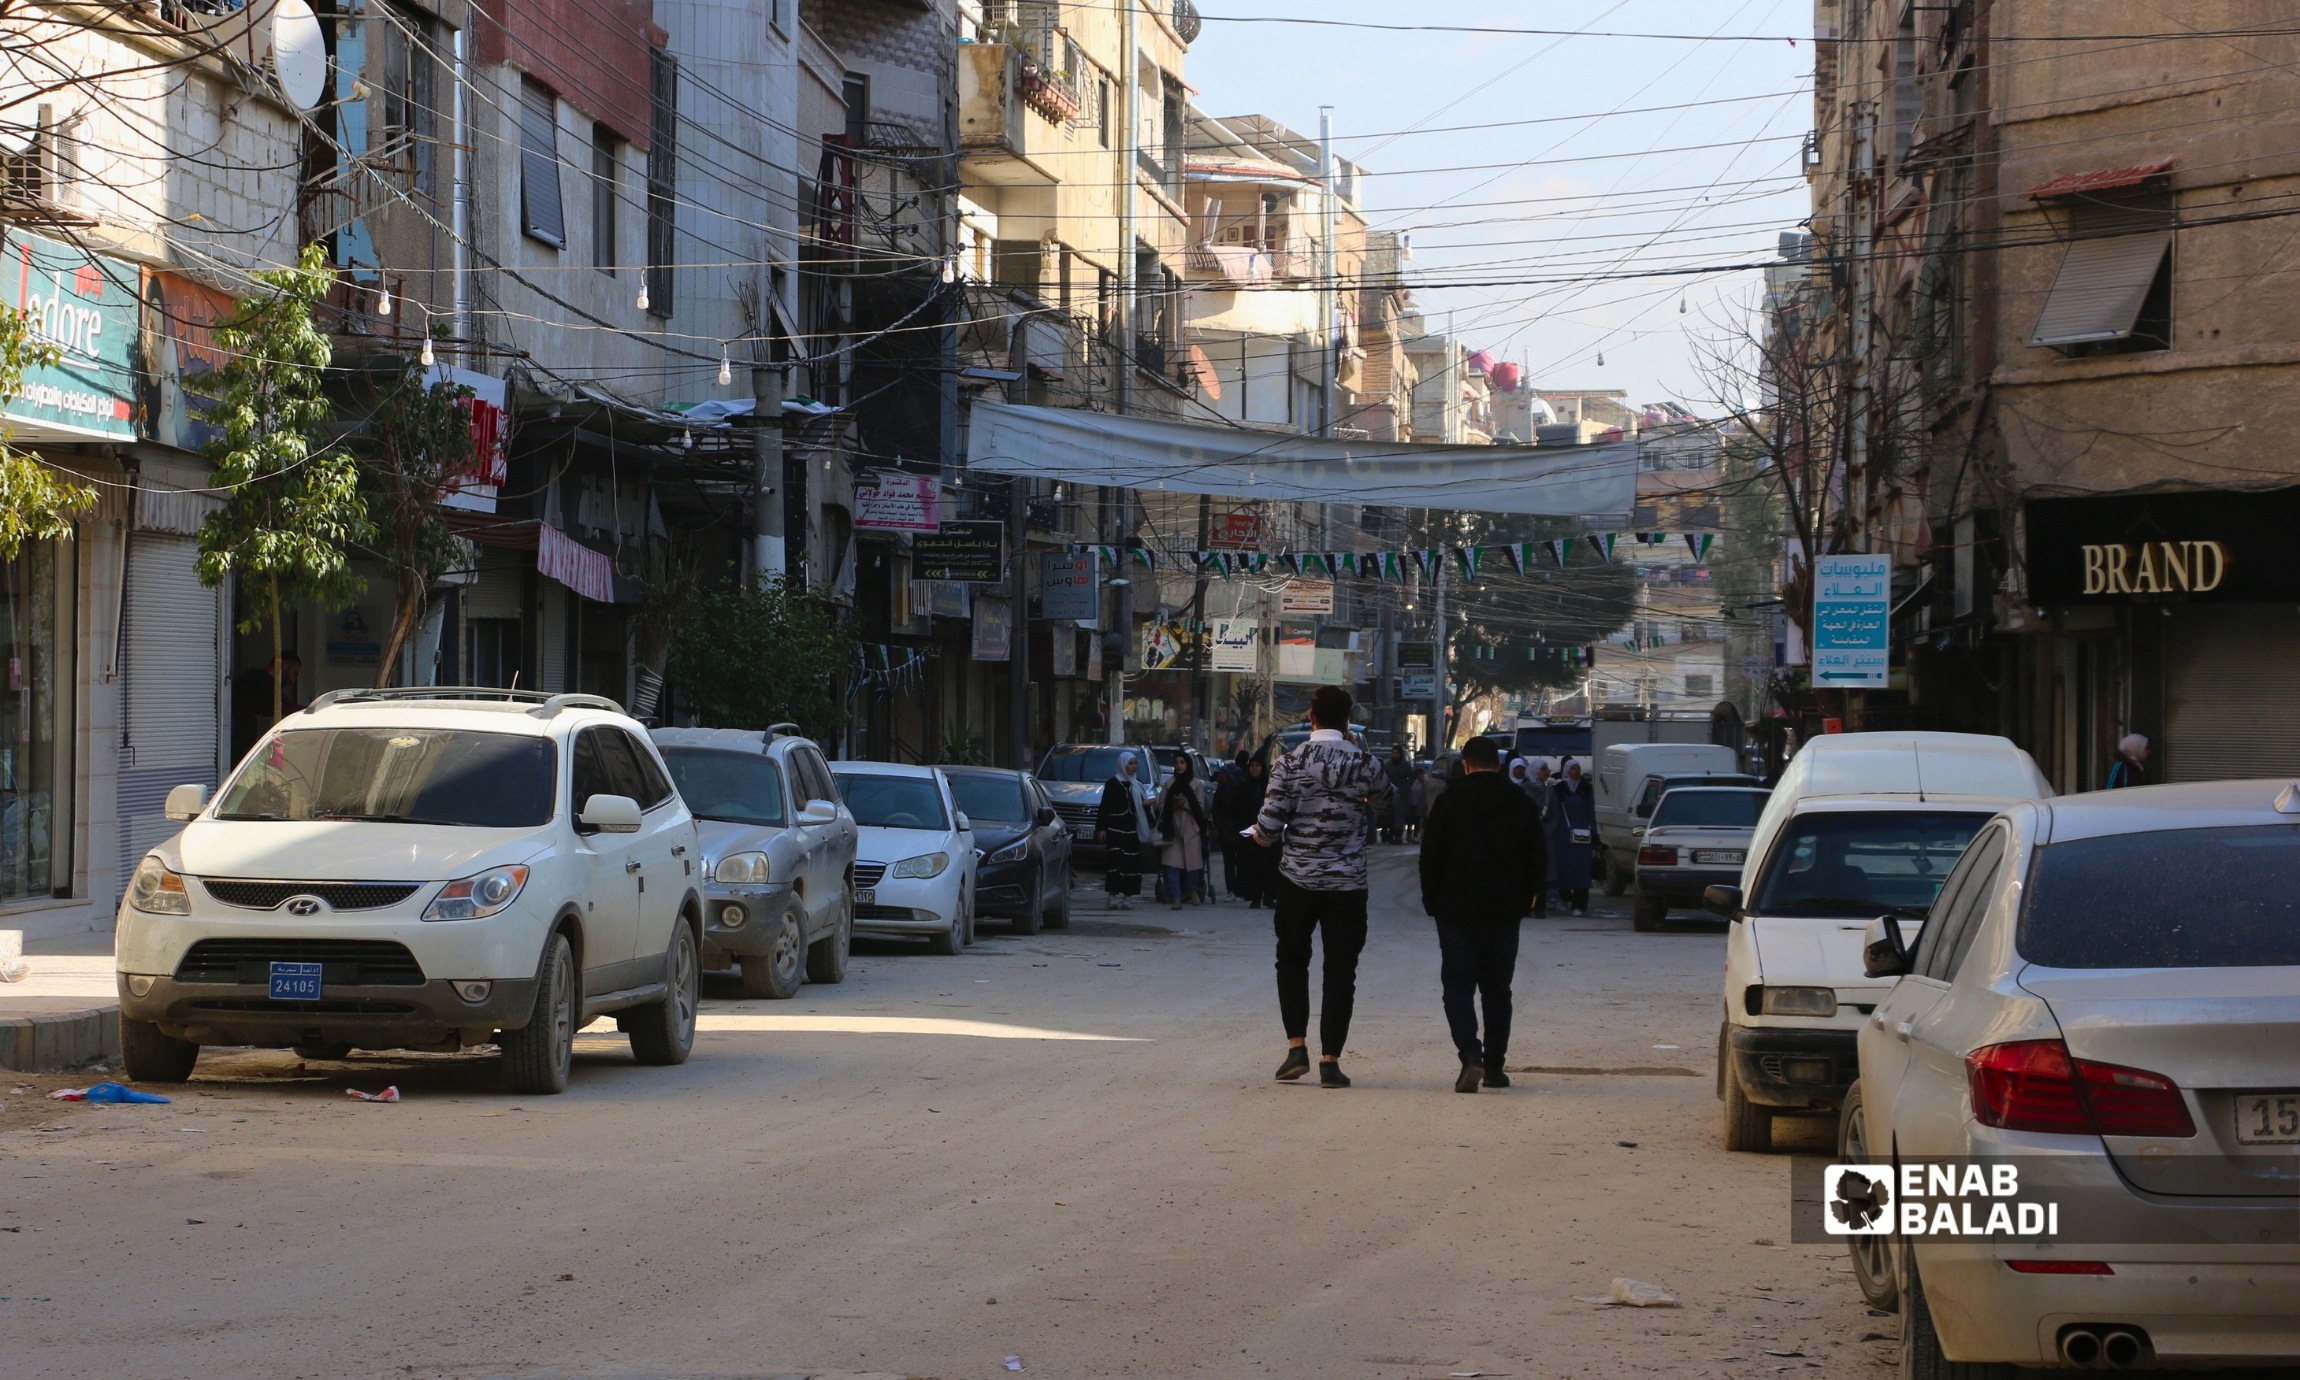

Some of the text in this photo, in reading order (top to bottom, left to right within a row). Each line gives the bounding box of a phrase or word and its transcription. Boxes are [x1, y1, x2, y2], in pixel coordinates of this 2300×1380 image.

[883, 488, 896, 499] فؤاد
[942, 527, 973, 535] الدكتورة
[1820, 560, 1886, 579] ملبوسات
[2082, 541, 2224, 594] BRAND
[1046, 575, 1090, 587] هاوس
[1823, 582, 1882, 597] العلاء
[1832, 605, 1859, 616] المحل
[1860, 604, 1885, 616] انتقل
[1822, 620, 1881, 632] الحارة في الجهة
[1831, 634, 1871, 646] المقابلة
[1818, 654, 1885, 667] سنتر العلاء
[275, 980, 314, 993] 24105
